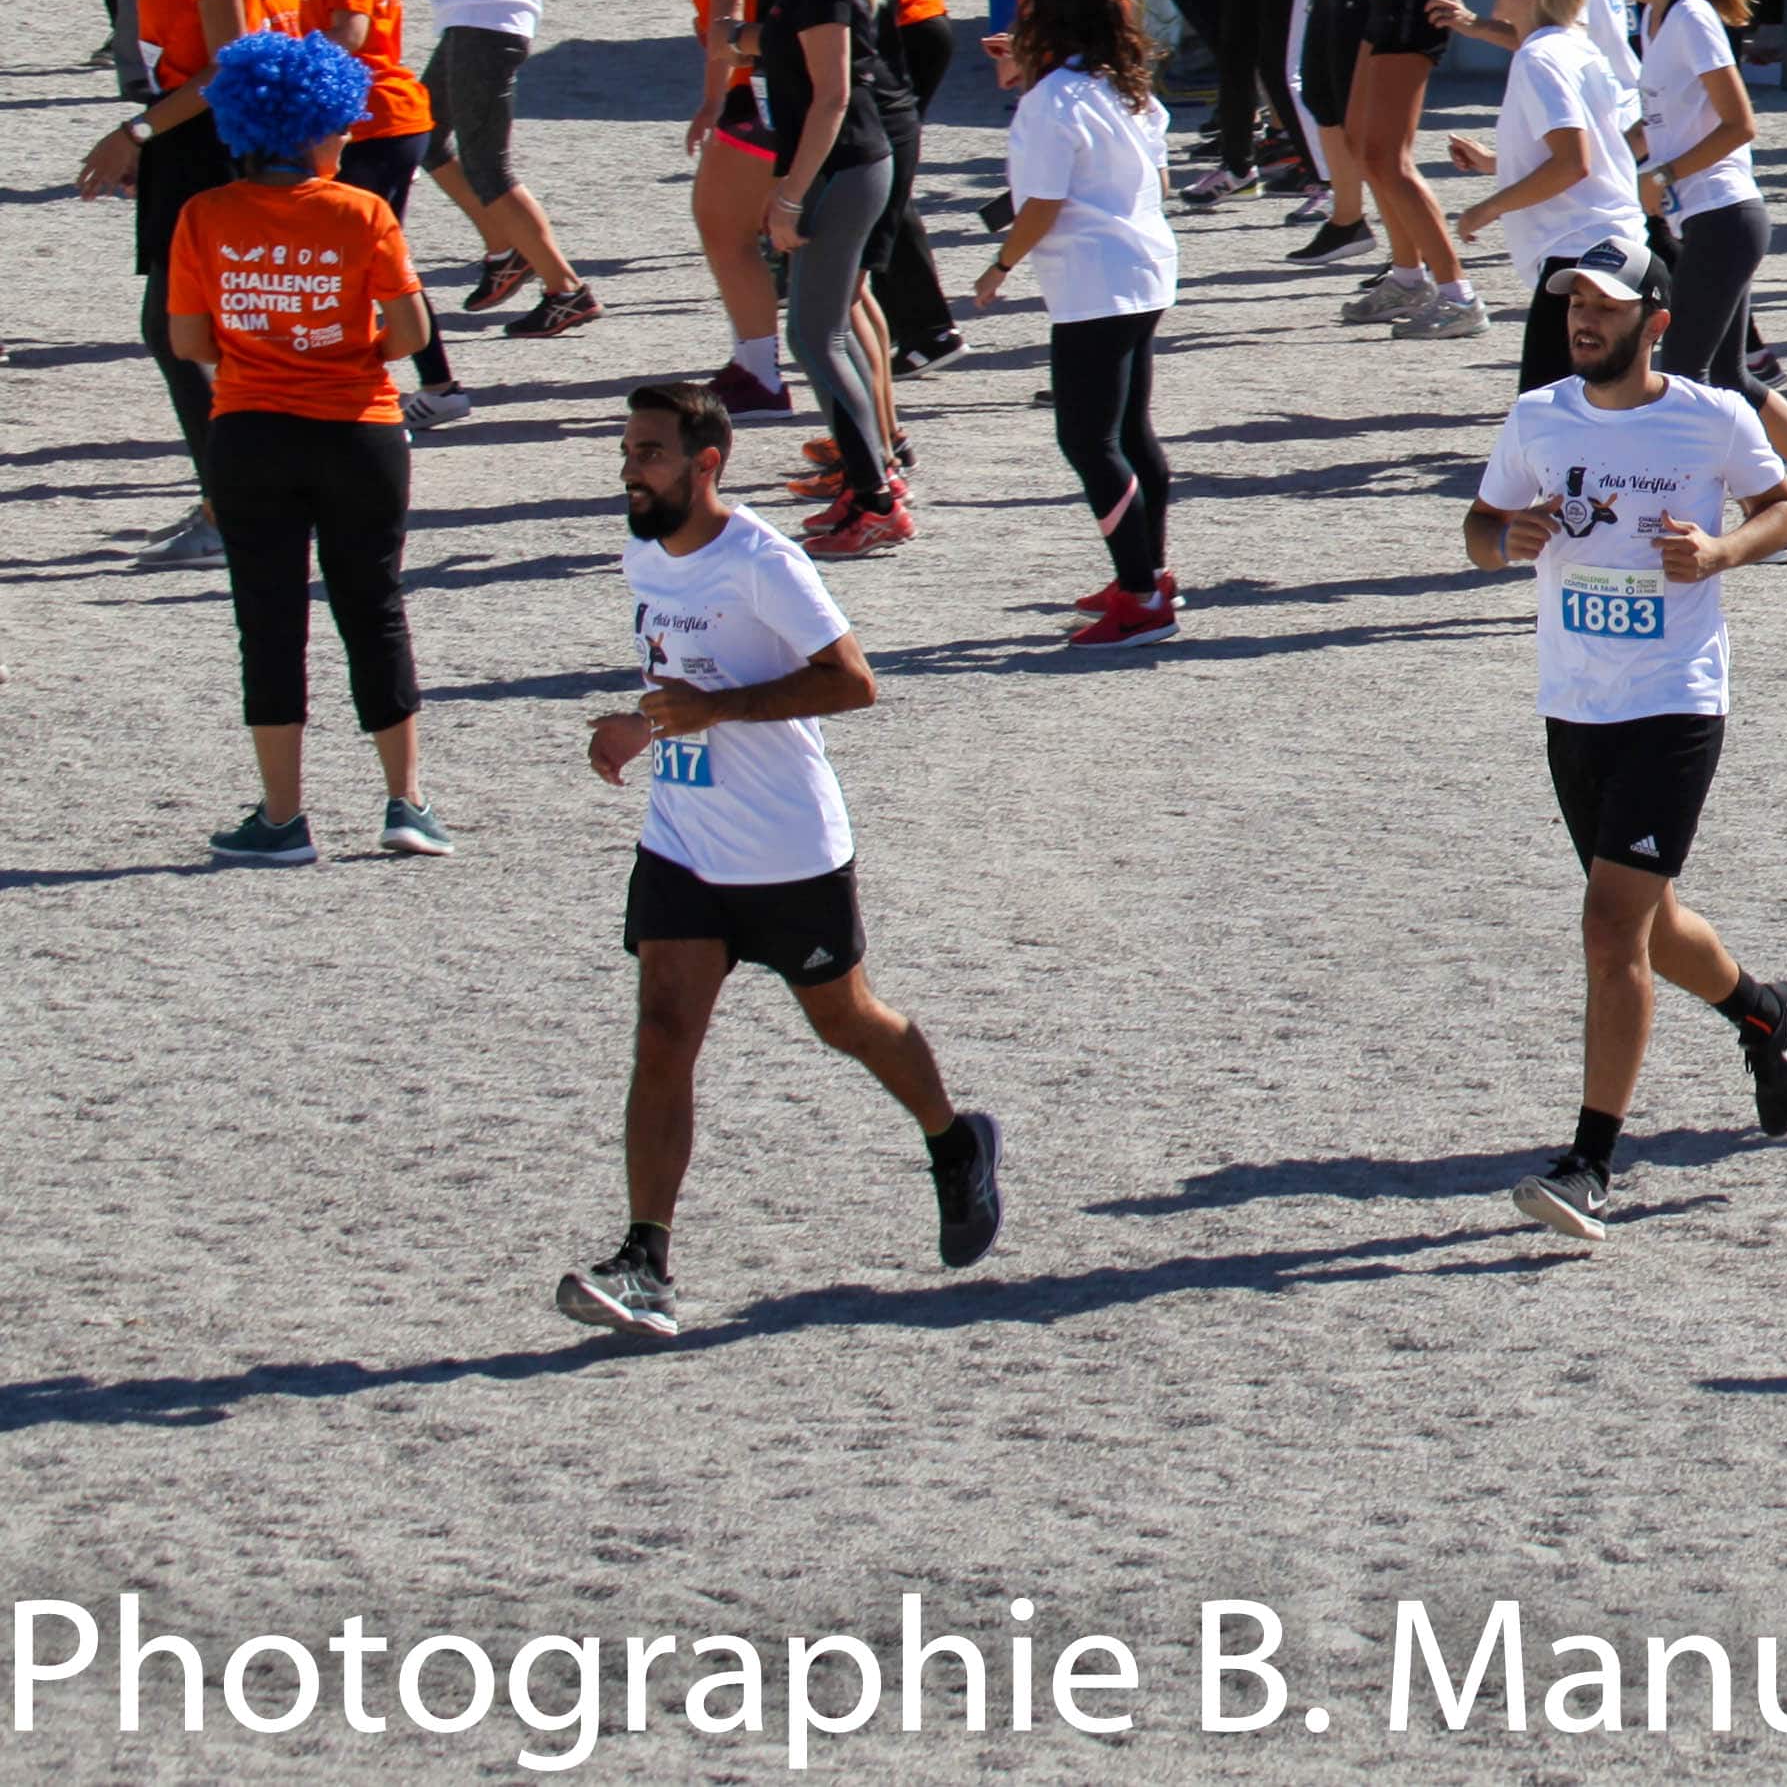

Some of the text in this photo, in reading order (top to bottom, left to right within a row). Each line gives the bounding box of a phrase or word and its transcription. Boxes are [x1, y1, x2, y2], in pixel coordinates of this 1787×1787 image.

[220, 271, 342, 294] CHALLENGE
[220, 292, 340, 314] CONTRE LA
[220, 312, 270, 332] FAIM
[1598, 473, 1678, 494] Avis Vérifiés
[1566, 592, 1657, 635] 1883
[652, 740, 704, 782] 817
